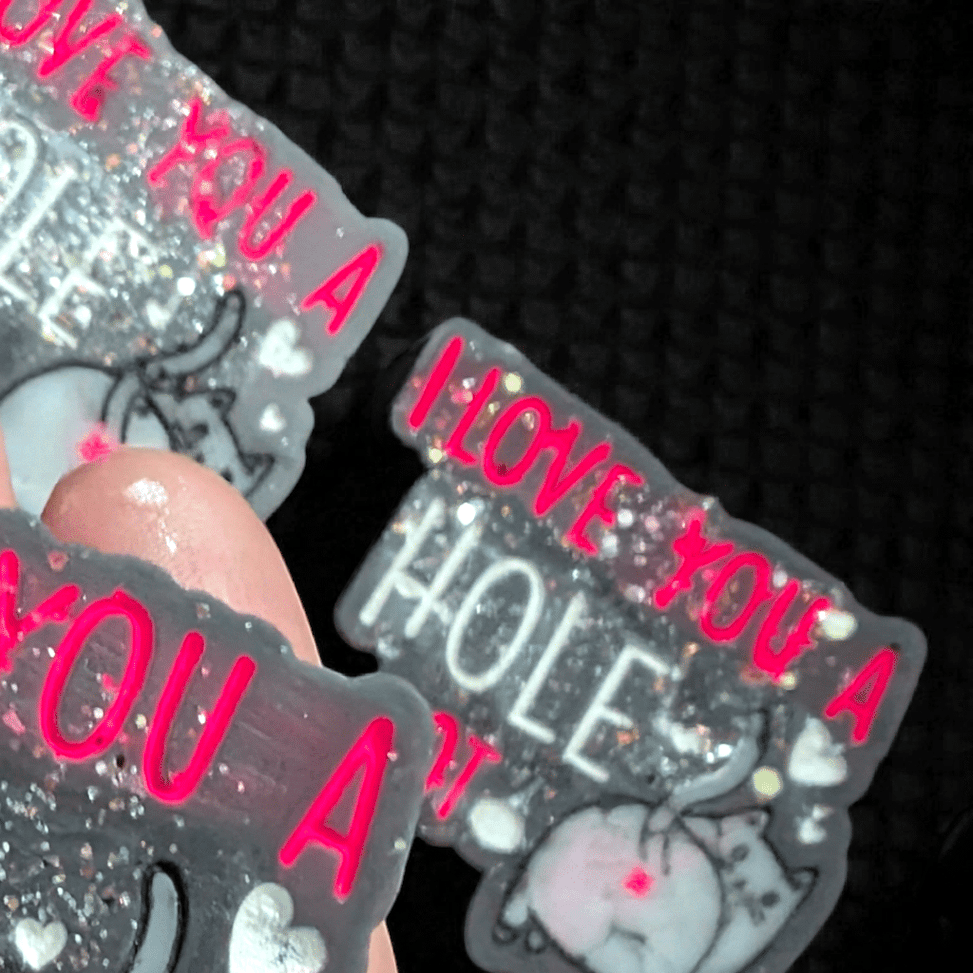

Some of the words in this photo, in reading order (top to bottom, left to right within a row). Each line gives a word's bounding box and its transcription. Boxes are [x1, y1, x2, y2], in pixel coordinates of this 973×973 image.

[147, 99, 317, 261] YOU
[302, 244, 383, 335] A
[358, 497, 670, 783] HOLE
[408, 335, 464, 431] I
[442, 367, 644, 555] LOVE
[653, 508, 833, 682] YOU
[824, 646, 902, 746] A
[278, 716, 395, 900] A
